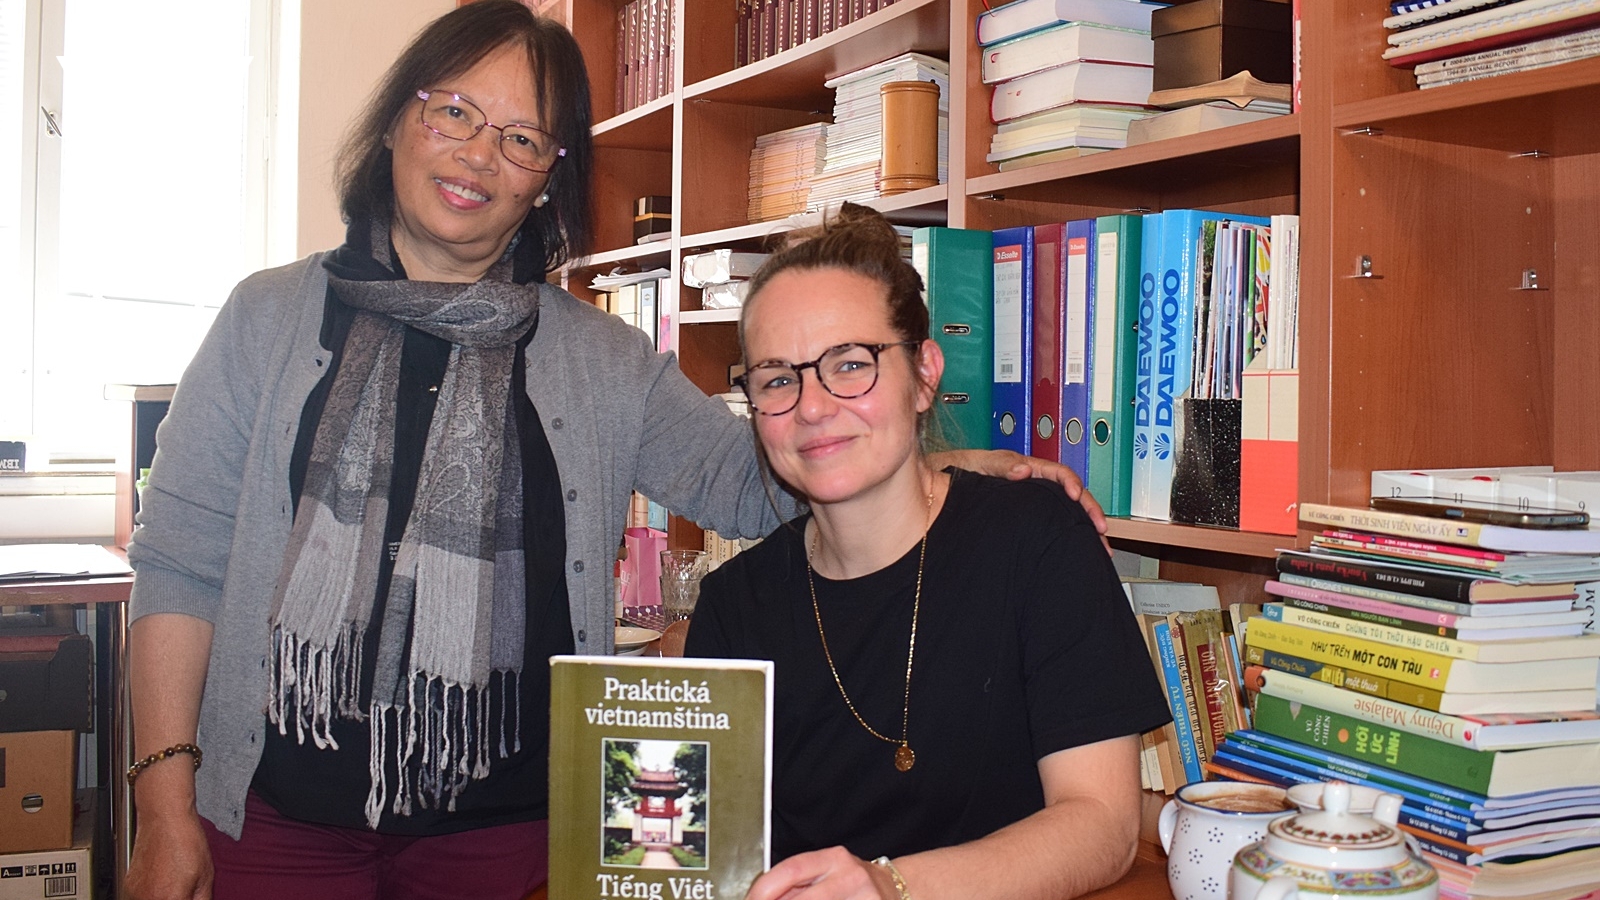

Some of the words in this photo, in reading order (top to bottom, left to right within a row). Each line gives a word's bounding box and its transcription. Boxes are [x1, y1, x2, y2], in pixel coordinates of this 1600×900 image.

[1469, 64, 1493, 73] ANNUAL
[1494, 59, 1519, 69] REPORT
[1478, 51, 1501, 61] ANNUAL
[1503, 46, 1527, 56] REPORT
[1001, 251, 1019, 260] Esselte
[1135, 272, 1155, 427] DAEWOO
[1155, 268, 1180, 427] DAEWOO
[1390, 486, 1402, 498] 12
[1453, 493, 1464, 504] 11
[1517, 497, 1530, 511] 10
[1578, 501, 1586, 512] 9
[1370, 517, 1390, 529] SINH
[1306, 616, 1321, 626] CÔNG
[1322, 618, 1340, 629] CHIẾN
[1345, 621, 1368, 635] CHÚNG
[1370, 627, 1383, 638] TÔI
[1425, 636, 1450, 652] CHIẾN
[1311, 641, 1328, 653] NHƯ
[1330, 643, 1350, 659] TRÊN
[1352, 649, 1375, 666] MỘT
[1377, 656, 1398, 671] CON
[1402, 656, 1423, 676] TÀU
[604, 677, 711, 704] Praktická
[1170, 685, 1180, 701] TỰ
[1345, 677, 1360, 688] một
[585, 702, 730, 730] vietnamština
[1175, 703, 1187, 738] THIÊN
[1305, 720, 1313, 732] VŨ
[1354, 699, 1407, 726] Malajsie
[1410, 709, 1455, 739] Dějiny
[1314, 714, 1323, 742] CÔNG
[1322, 715, 1331, 746] CHIẾN
[1355, 725, 1369, 754] HỒI
[1181, 740, 1192, 764] NGŨ
[1370, 733, 1384, 754] ỨC
[1385, 731, 1401, 765] LÍNH
[596, 873, 663, 900] Tiếng
